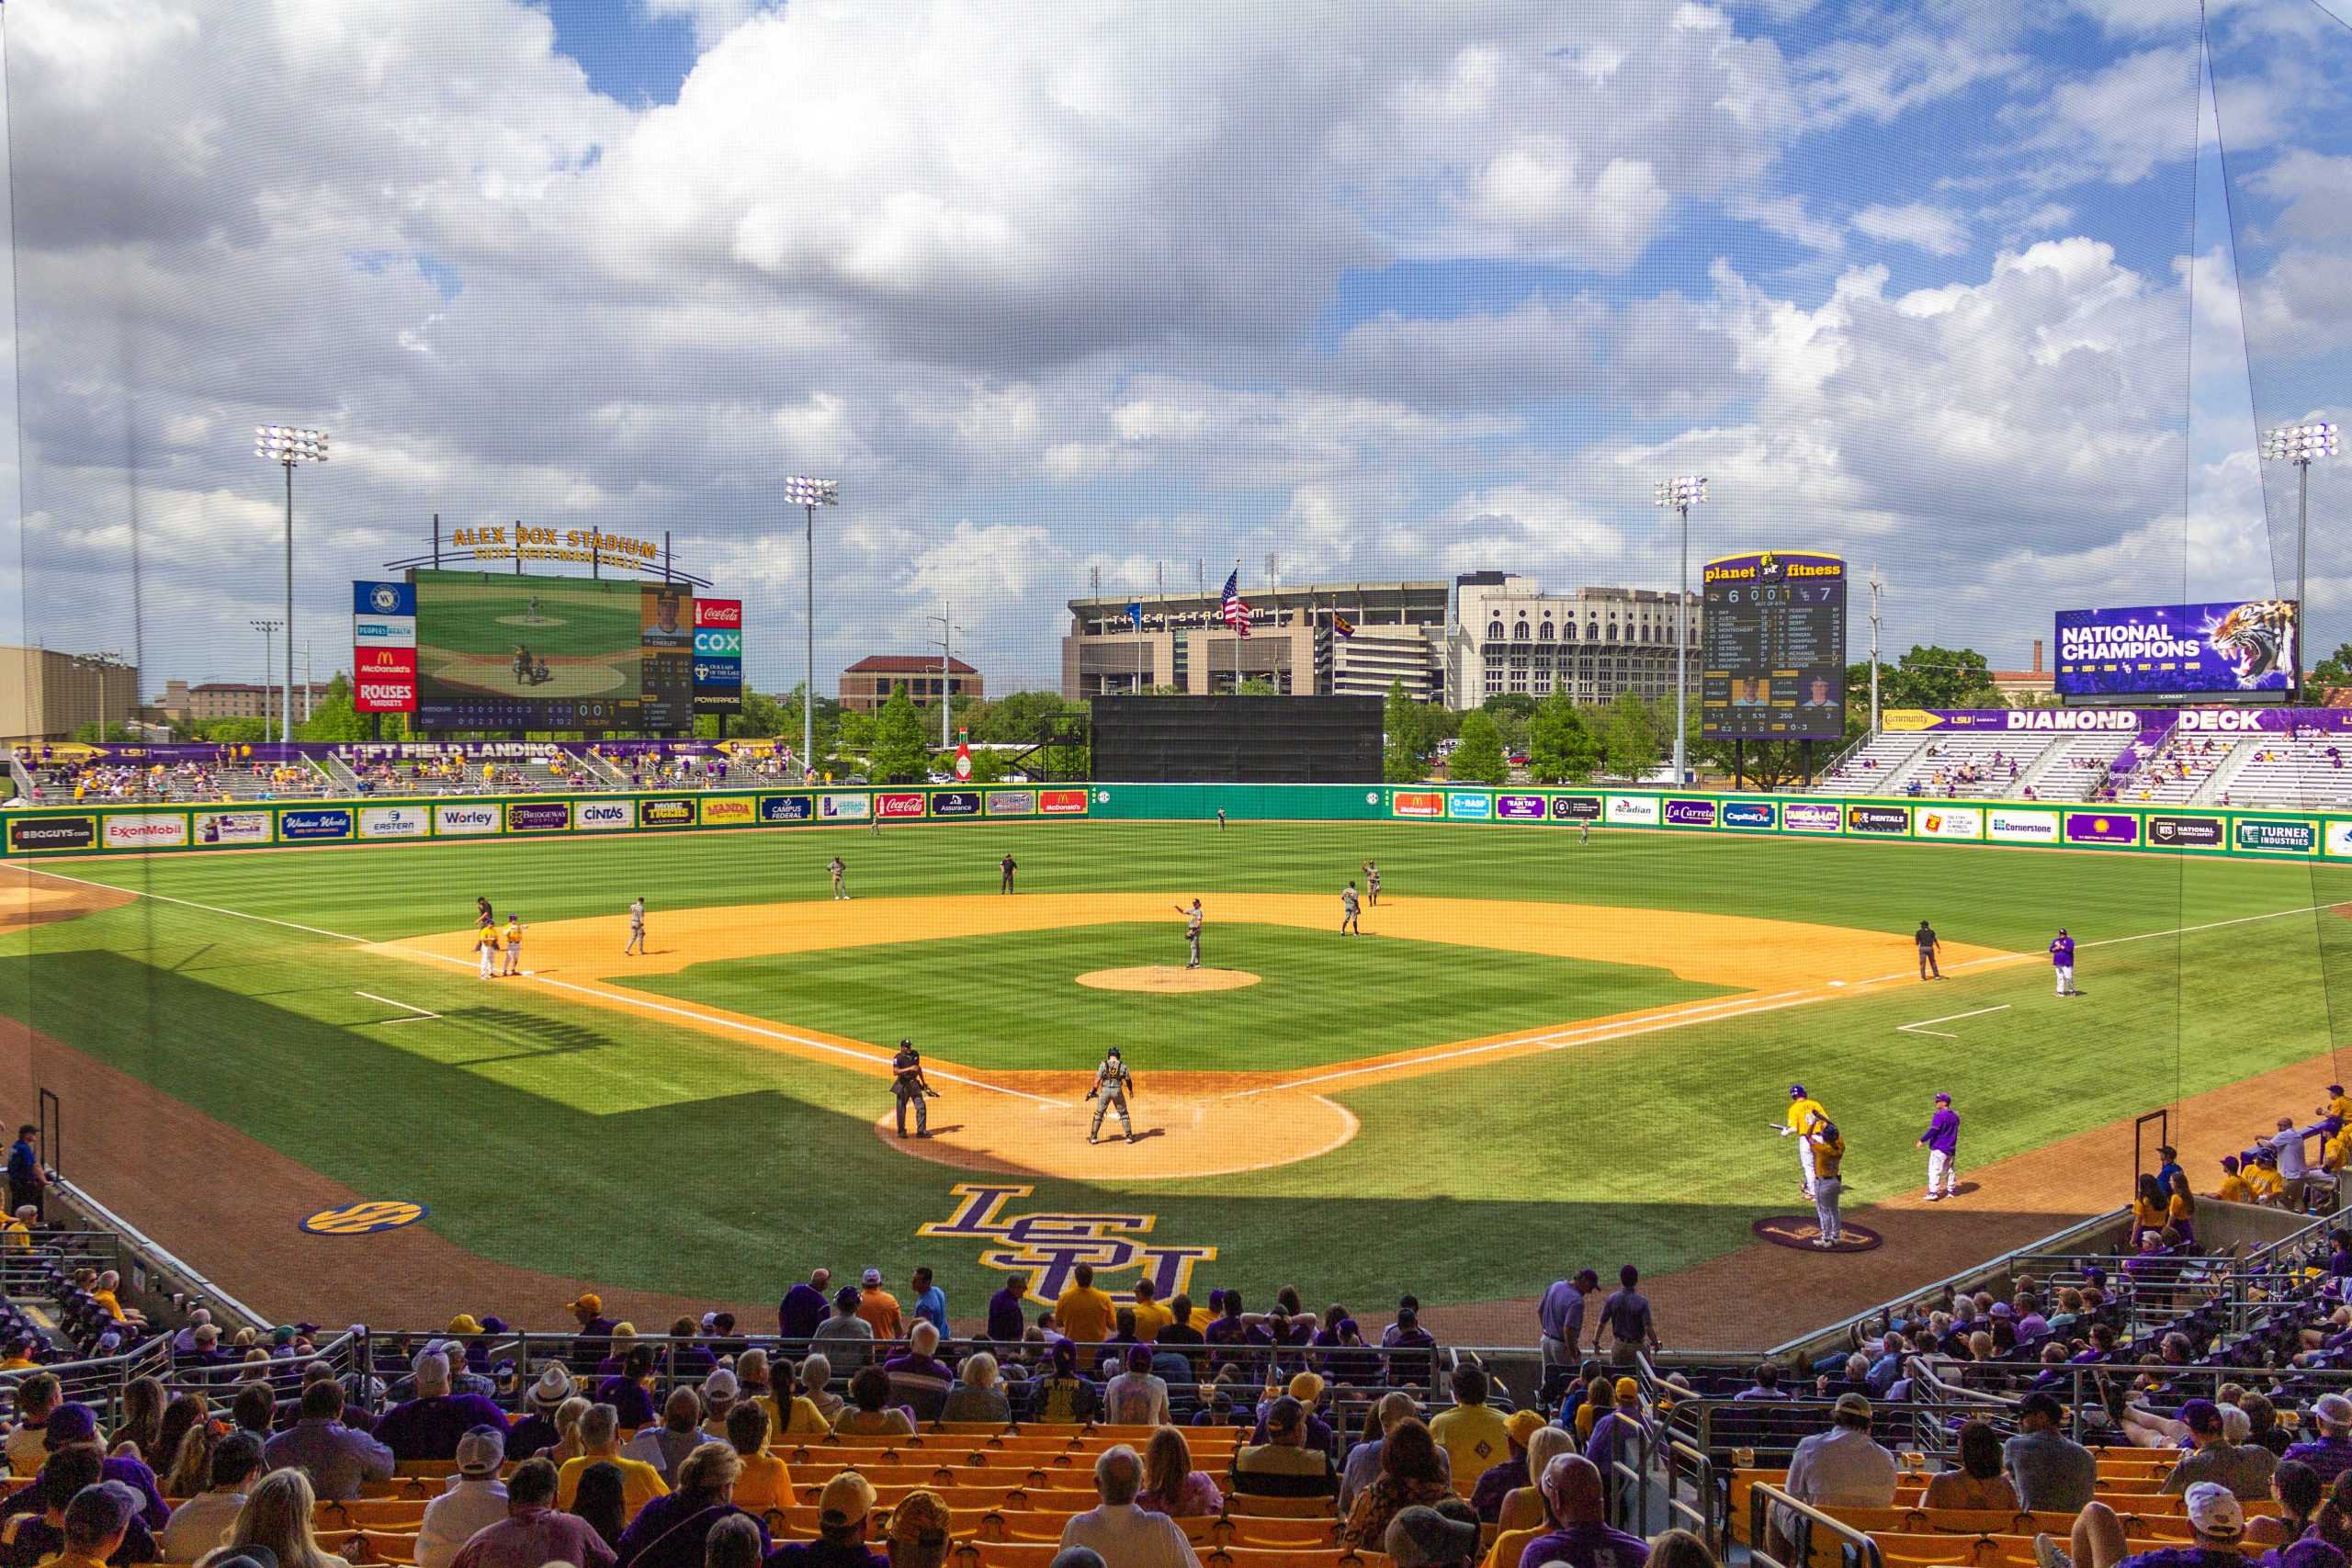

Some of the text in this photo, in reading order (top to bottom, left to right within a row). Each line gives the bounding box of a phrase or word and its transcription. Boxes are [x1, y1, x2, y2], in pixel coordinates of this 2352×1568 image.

[453, 526, 657, 559] ALEX BOX STADIUM
[474, 547, 641, 570] SKIP BERTMAN FIELD
[1704, 564, 1841, 583] planet pf fitness
[1728, 590, 1739, 603] 6
[1750, 589, 1791, 601] 0 0 1
[1819, 588, 1830, 601] 7
[1179, 608, 1264, 622] STADM
[2062, 624, 2173, 644] NATIONAL
[695, 633, 741, 651] COX
[2062, 640, 2200, 660] CHAMPIONS
[361, 665, 412, 673] McDonald's
[360, 684, 412, 700] ROUSES
[580, 705, 588, 716] 0
[593, 705, 602, 716] 0
[1884, 713, 1928, 726] Community
[2007, 711, 2264, 730] DIAMOND DECK
[339, 742, 560, 759] LEFT FIELD LANDING
[886, 797, 922, 813] Coca-Cola
[1614, 805, 1652, 815] Acadian
[1666, 805, 1714, 819] La Carreta
[445, 811, 492, 826] Worley
[523, 810, 566, 818] BRIDGEWAY
[584, 806, 624, 820] CINTAS
[1870, 815, 1905, 823] RENTALS
[286, 815, 347, 829] Window World
[374, 822, 414, 830] EASTERN
[2005, 823, 2052, 833] Cornerstone
[109, 824, 181, 839] ExxonMobil
[2177, 826, 2215, 834] NATIONAL
[2260, 826, 2309, 838] TURNER
[2260, 836, 2309, 846] INDUSTRIES
[915, 1183, 1217, 1306] LSU
